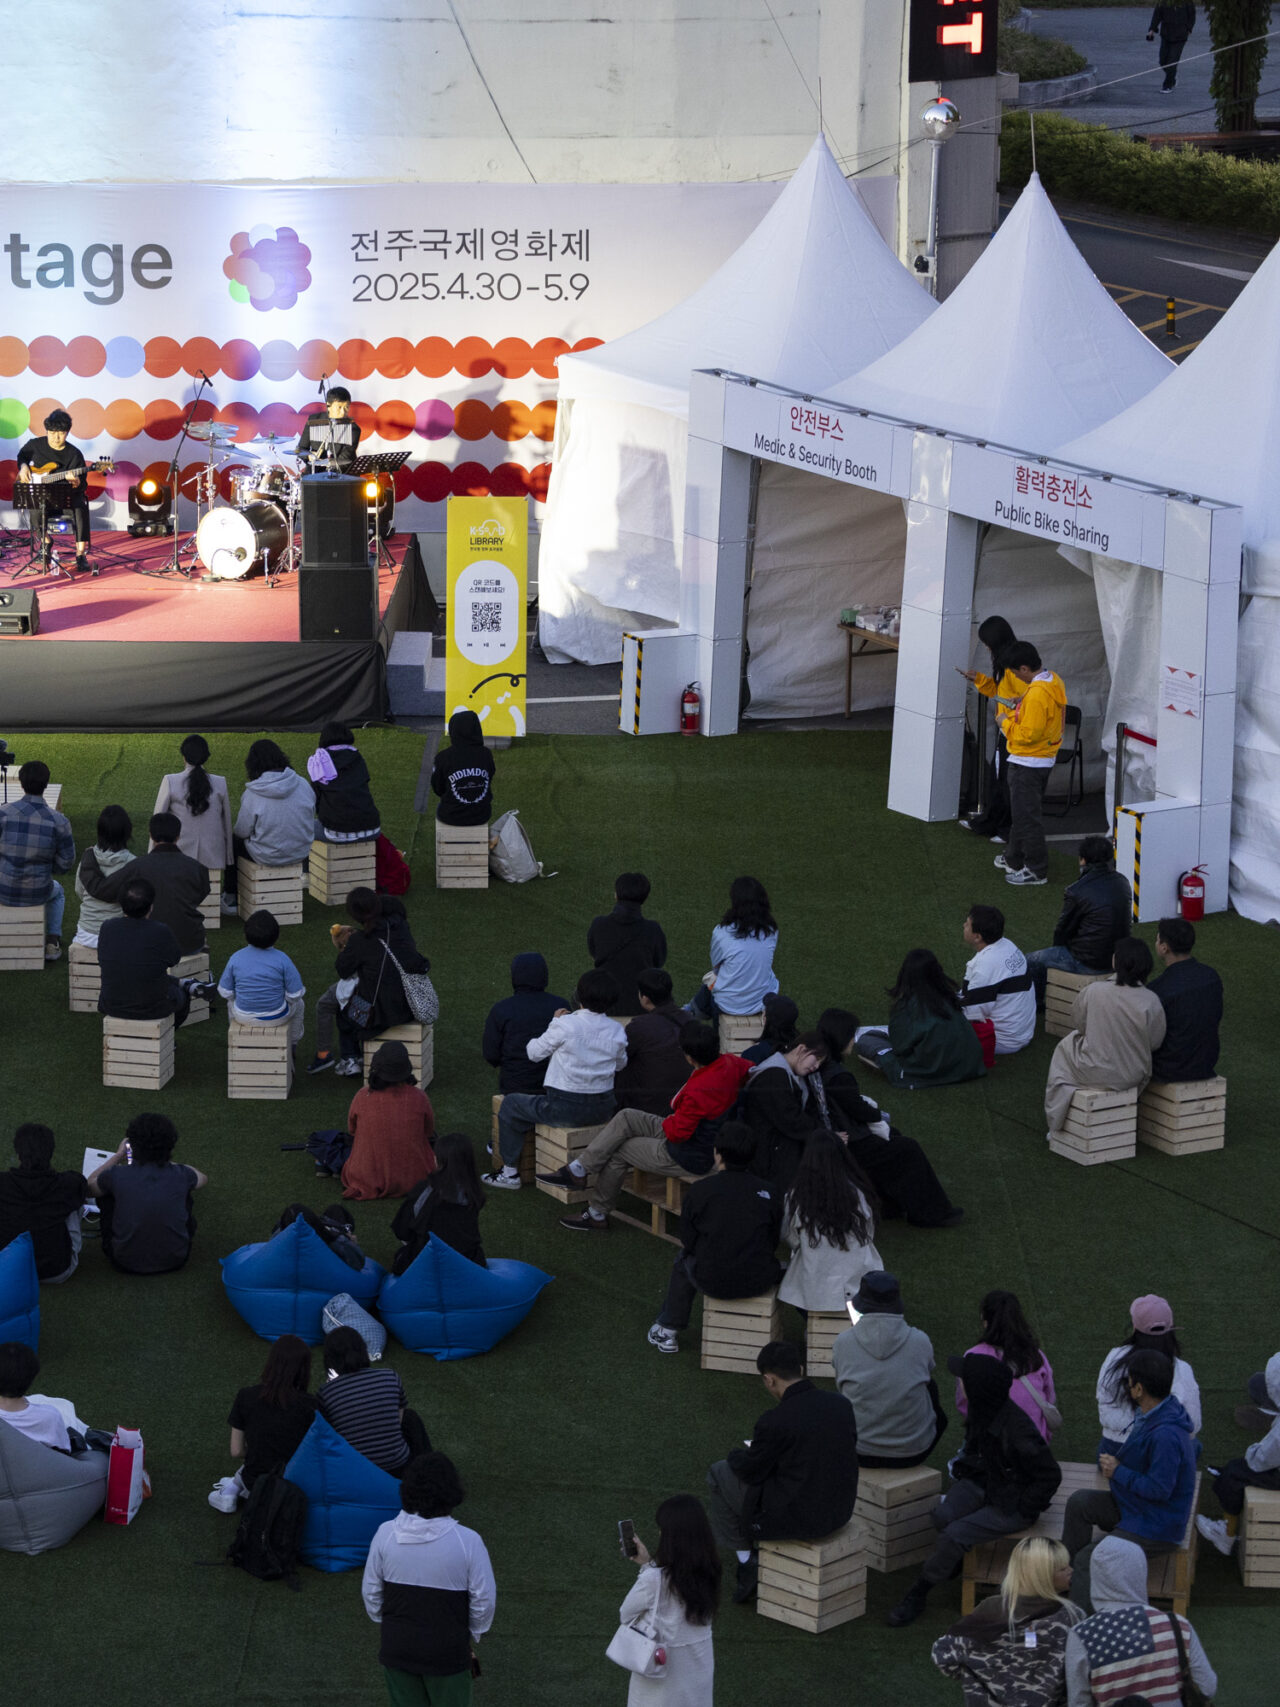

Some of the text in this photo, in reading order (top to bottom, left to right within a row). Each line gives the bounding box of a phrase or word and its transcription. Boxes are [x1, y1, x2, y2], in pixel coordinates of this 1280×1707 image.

[350, 228, 590, 262] 전주국제영화제
[352, 272, 590, 302] 2025.4.30-5.9
[790, 406, 844, 441] 안전부스
[754, 433, 877, 482] Medic & Security Booth
[1015, 465, 1093, 509] 활력충전소
[470, 537, 504, 545] LIBRARY
[994, 500, 1110, 552] Public Bike Sharing
